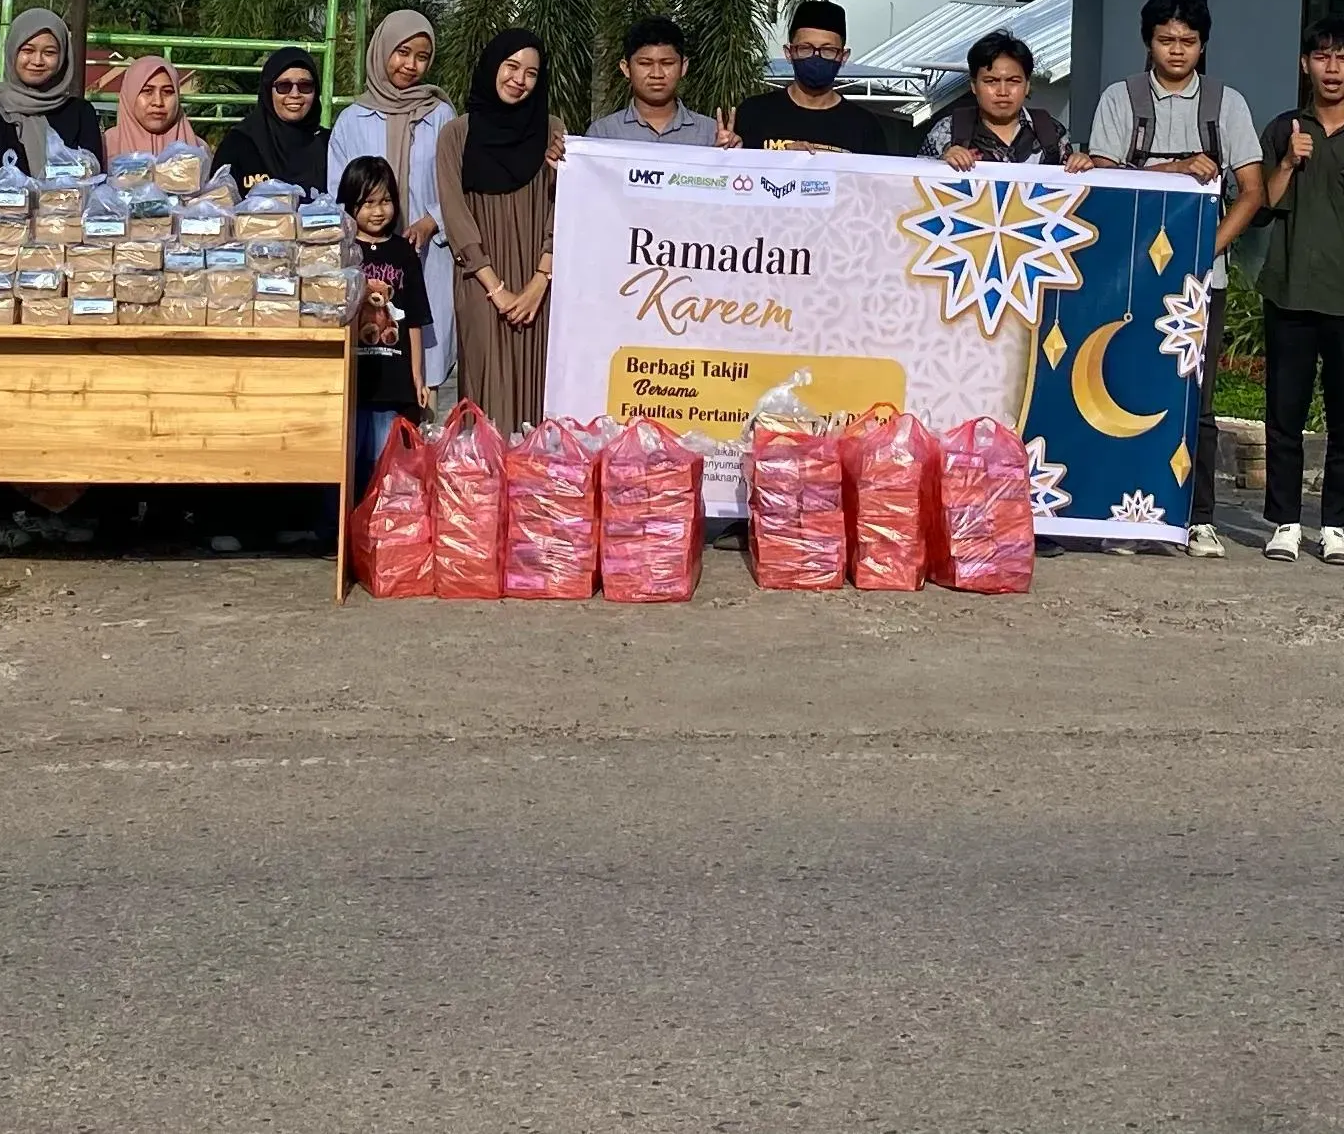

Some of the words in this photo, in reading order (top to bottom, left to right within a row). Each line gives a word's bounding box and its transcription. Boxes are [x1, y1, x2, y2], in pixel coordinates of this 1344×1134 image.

[629, 168, 664, 185] UMKT
[627, 227, 812, 275] Ramadan
[619, 267, 793, 336] Kareem
[626, 357, 695, 380] Berbagi
[701, 360, 749, 382] Takjil
[633, 378, 699, 398] Bersama
[621, 402, 683, 420] Fakultas
[688, 406, 750, 423] Pertania
